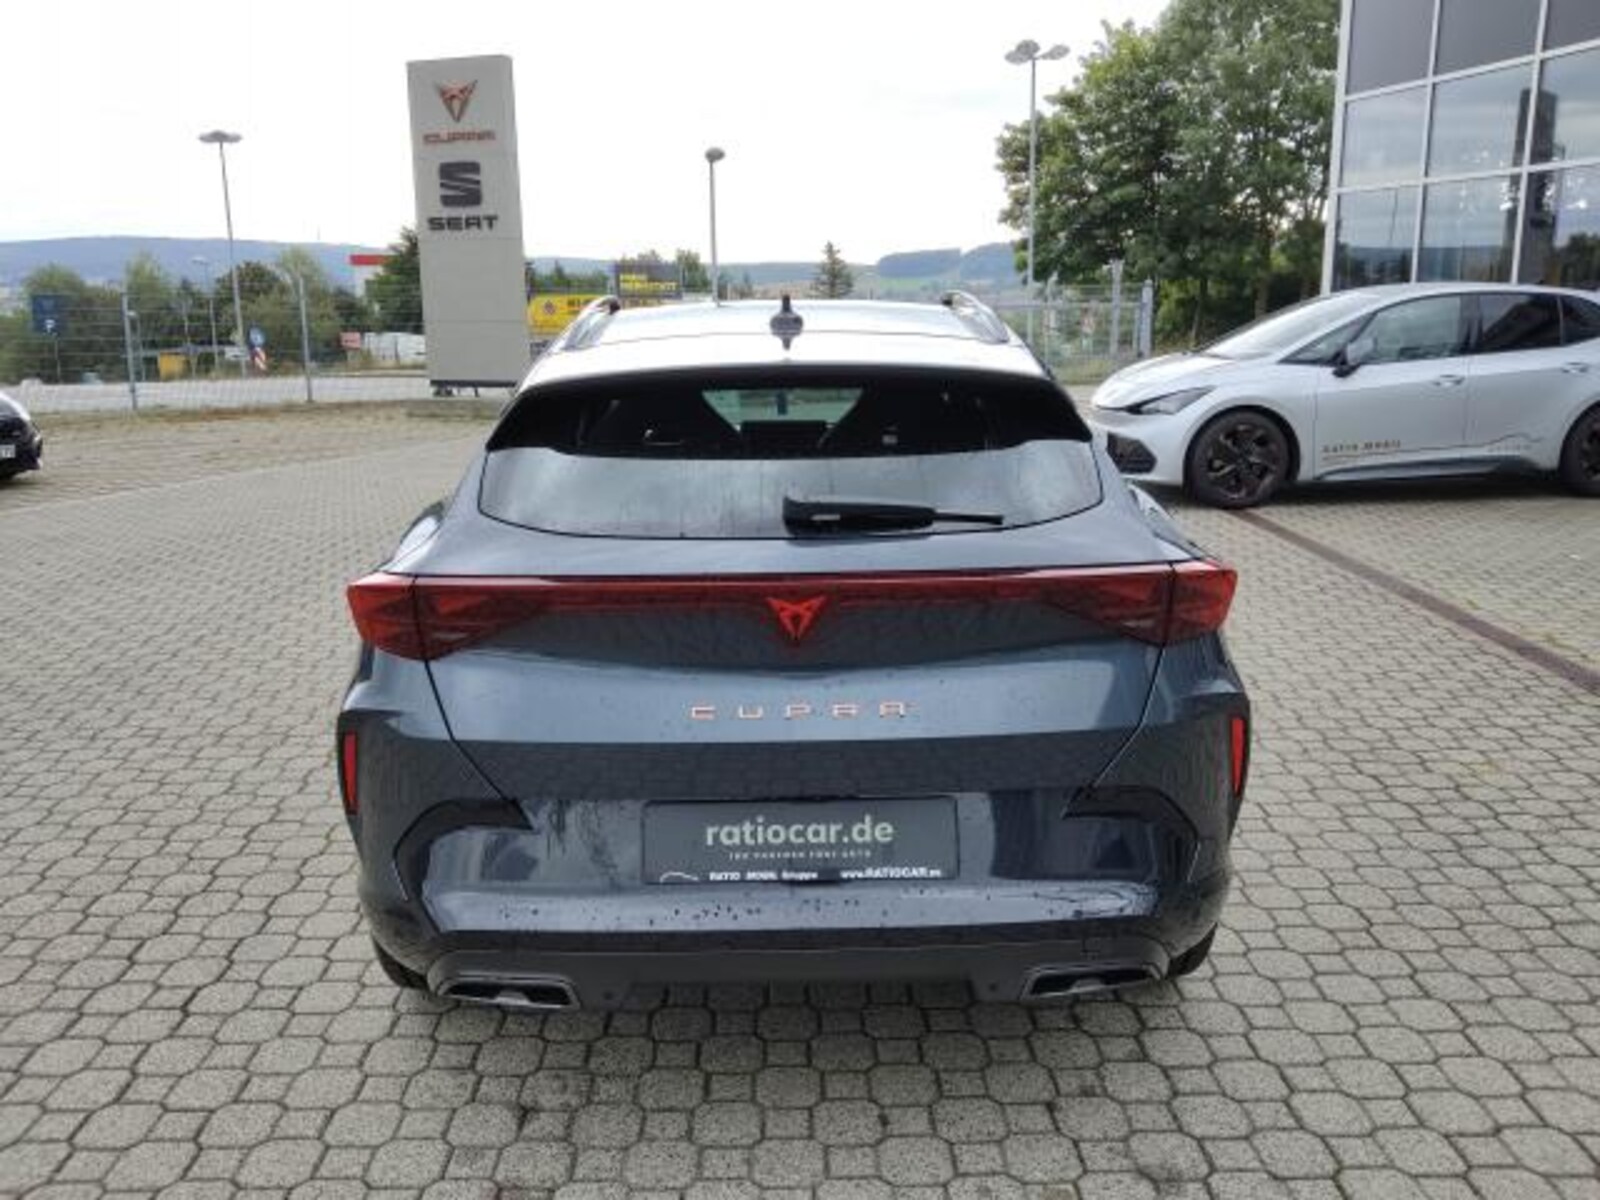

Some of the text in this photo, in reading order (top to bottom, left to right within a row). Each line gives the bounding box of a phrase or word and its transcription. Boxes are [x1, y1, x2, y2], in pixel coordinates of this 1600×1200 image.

[427, 214, 499, 231] SEAT
[690, 701, 905, 720] CUPRA
[705, 814, 895, 847] ratiocar.de
